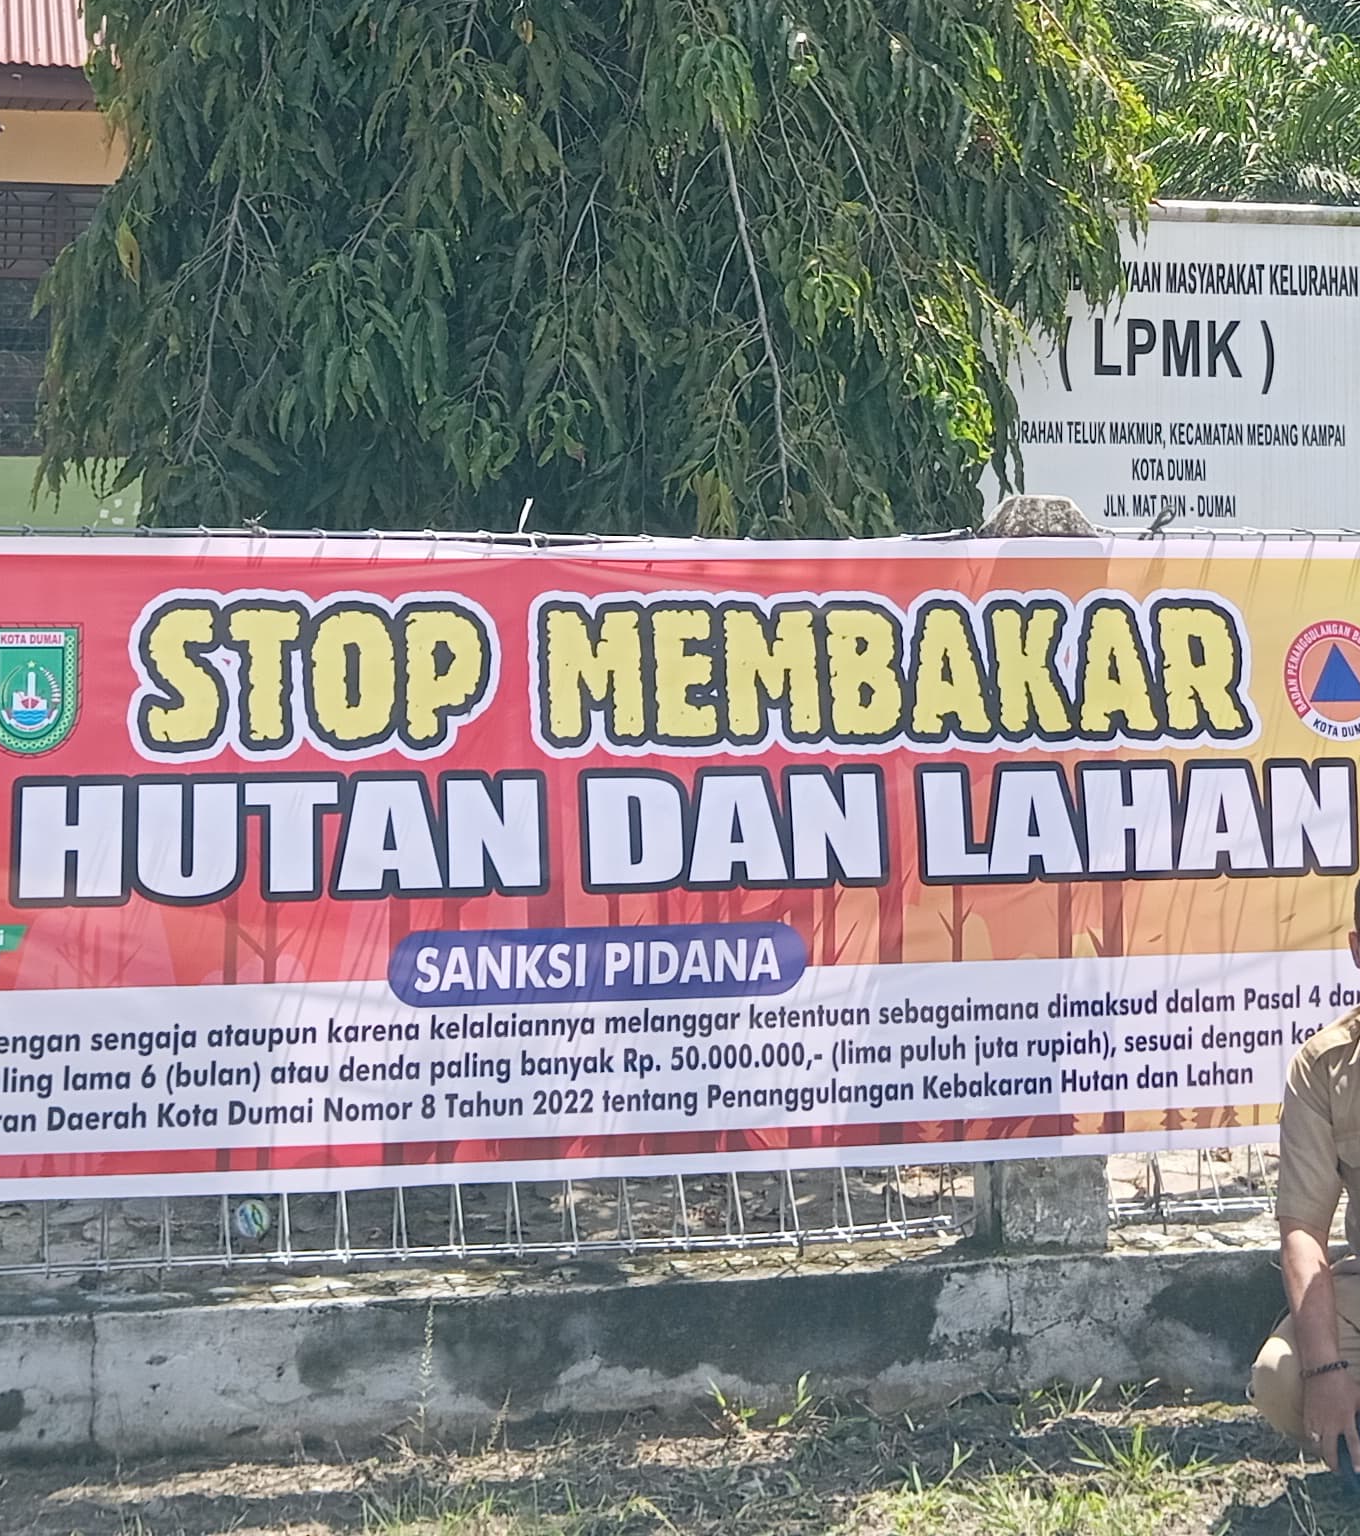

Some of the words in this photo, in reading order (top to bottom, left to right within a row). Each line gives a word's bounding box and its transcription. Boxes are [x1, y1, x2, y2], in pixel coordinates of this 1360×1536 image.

[1165, 261, 1265, 296] MASYARAKAT
[1269, 264, 1359, 297] KELURAHAN
[1093, 318, 1243, 378] LPMK
[1067, 421, 1106, 445] TELUK
[1109, 421, 1166, 449] MAKMUR,
[1169, 422, 1243, 446] KECAMATAN
[1247, 424, 1298, 447] MEDANG
[1301, 424, 1346, 447] KAMPAI
[1131, 458, 1165, 481] KOTA
[1168, 458, 1206, 482] DUMAI
[1103, 494, 1130, 518] JLN.
[1132, 494, 1157, 518] MAT
[1197, 495, 1236, 518] DUMAI
[0, 634, 27, 645] KOTA
[29, 634, 62, 645] DUMAI
[140, 600, 492, 751] STOP
[540, 599, 1251, 747] MEMBAKAR
[1313, 717, 1339, 737] KOTA
[14, 774, 544, 903] HUTAN
[584, 769, 885, 888] DAN
[919, 763, 1354, 877] LAHAN
[413, 943, 587, 994] SANKSI
[604, 937, 781, 987] PIDANA
[90, 1023, 197, 1056] sengaja
[207, 1023, 317, 1053] ataupun
[327, 1017, 420, 1044] karena
[430, 1012, 595, 1043] kelalaiannya
[604, 1007, 742, 1039] melanggar
[749, 1003, 871, 1030] ketentuan
[878, 996, 1039, 1030] sebagaimana
[1046, 989, 1158, 1019] dimaksud
[1165, 987, 1235, 1015] dalam
[1244, 984, 1301, 1010] Pasal
[1307, 984, 1322, 1008] 4
[63, 1064, 131, 1092] lama
[140, 1064, 157, 1090] 6
[165, 1060, 261, 1095] (bulan)
[270, 1060, 329, 1086] atau
[339, 1055, 420, 1083] denda
[429, 1051, 512, 1086] paling
[520, 1047, 614, 1082] banyak
[622, 1047, 662, 1078] Rp.
[671, 1040, 823, 1072] 50.000.000,-
[830, 1039, 891, 1072] (lima
[899, 1034, 967, 1068] puluh
[973, 1034, 1018, 1066] juta
[1026, 1029, 1117, 1063] rupiah),
[1123, 1026, 1194, 1053] sesuai
[1201, 1023, 1284, 1054] dengan
[46, 1102, 147, 1132] Daerah
[156, 1102, 218, 1129] Kota
[228, 1098, 314, 1126] Dumai
[323, 1096, 414, 1123] Nomor
[420, 1093, 437, 1120] 8
[444, 1090, 525, 1119] Tahun
[532, 1088, 595, 1116] 2022
[601, 1088, 699, 1117] tentang
[706, 1078, 915, 1112] Penanggulangan
[922, 1070, 1053, 1100] Kebakaran
[1060, 1068, 1129, 1094] Hutan
[1136, 1064, 1179, 1091] dan
[1186, 1062, 1255, 1088] Lahan
